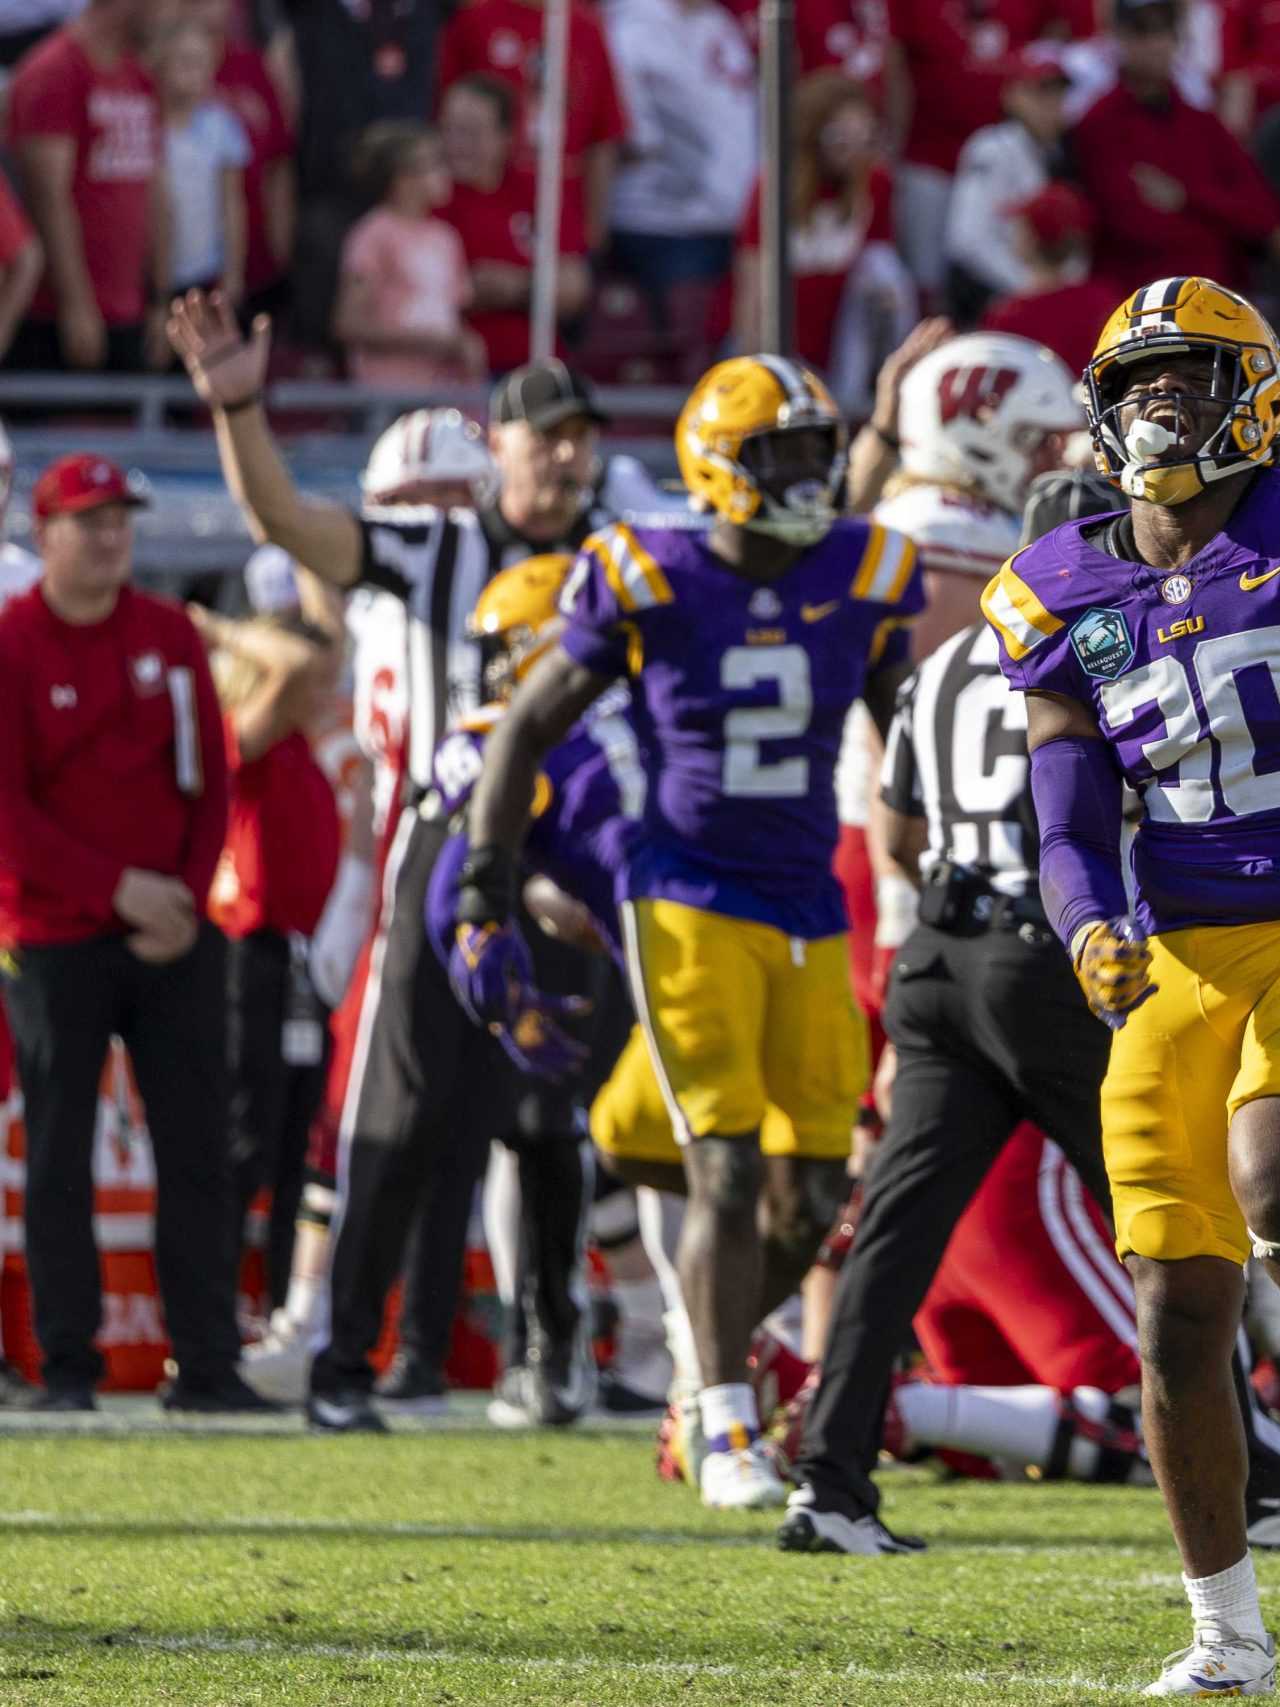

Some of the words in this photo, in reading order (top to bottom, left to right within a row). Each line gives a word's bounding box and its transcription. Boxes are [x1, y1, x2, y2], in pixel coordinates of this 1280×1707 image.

[938, 365, 1021, 427] W
[1086, 650, 1125, 669] RELIAQUEST
[1157, 615, 1205, 643] LSU
[720, 645, 812, 797] 2
[953, 674, 1028, 812] C
